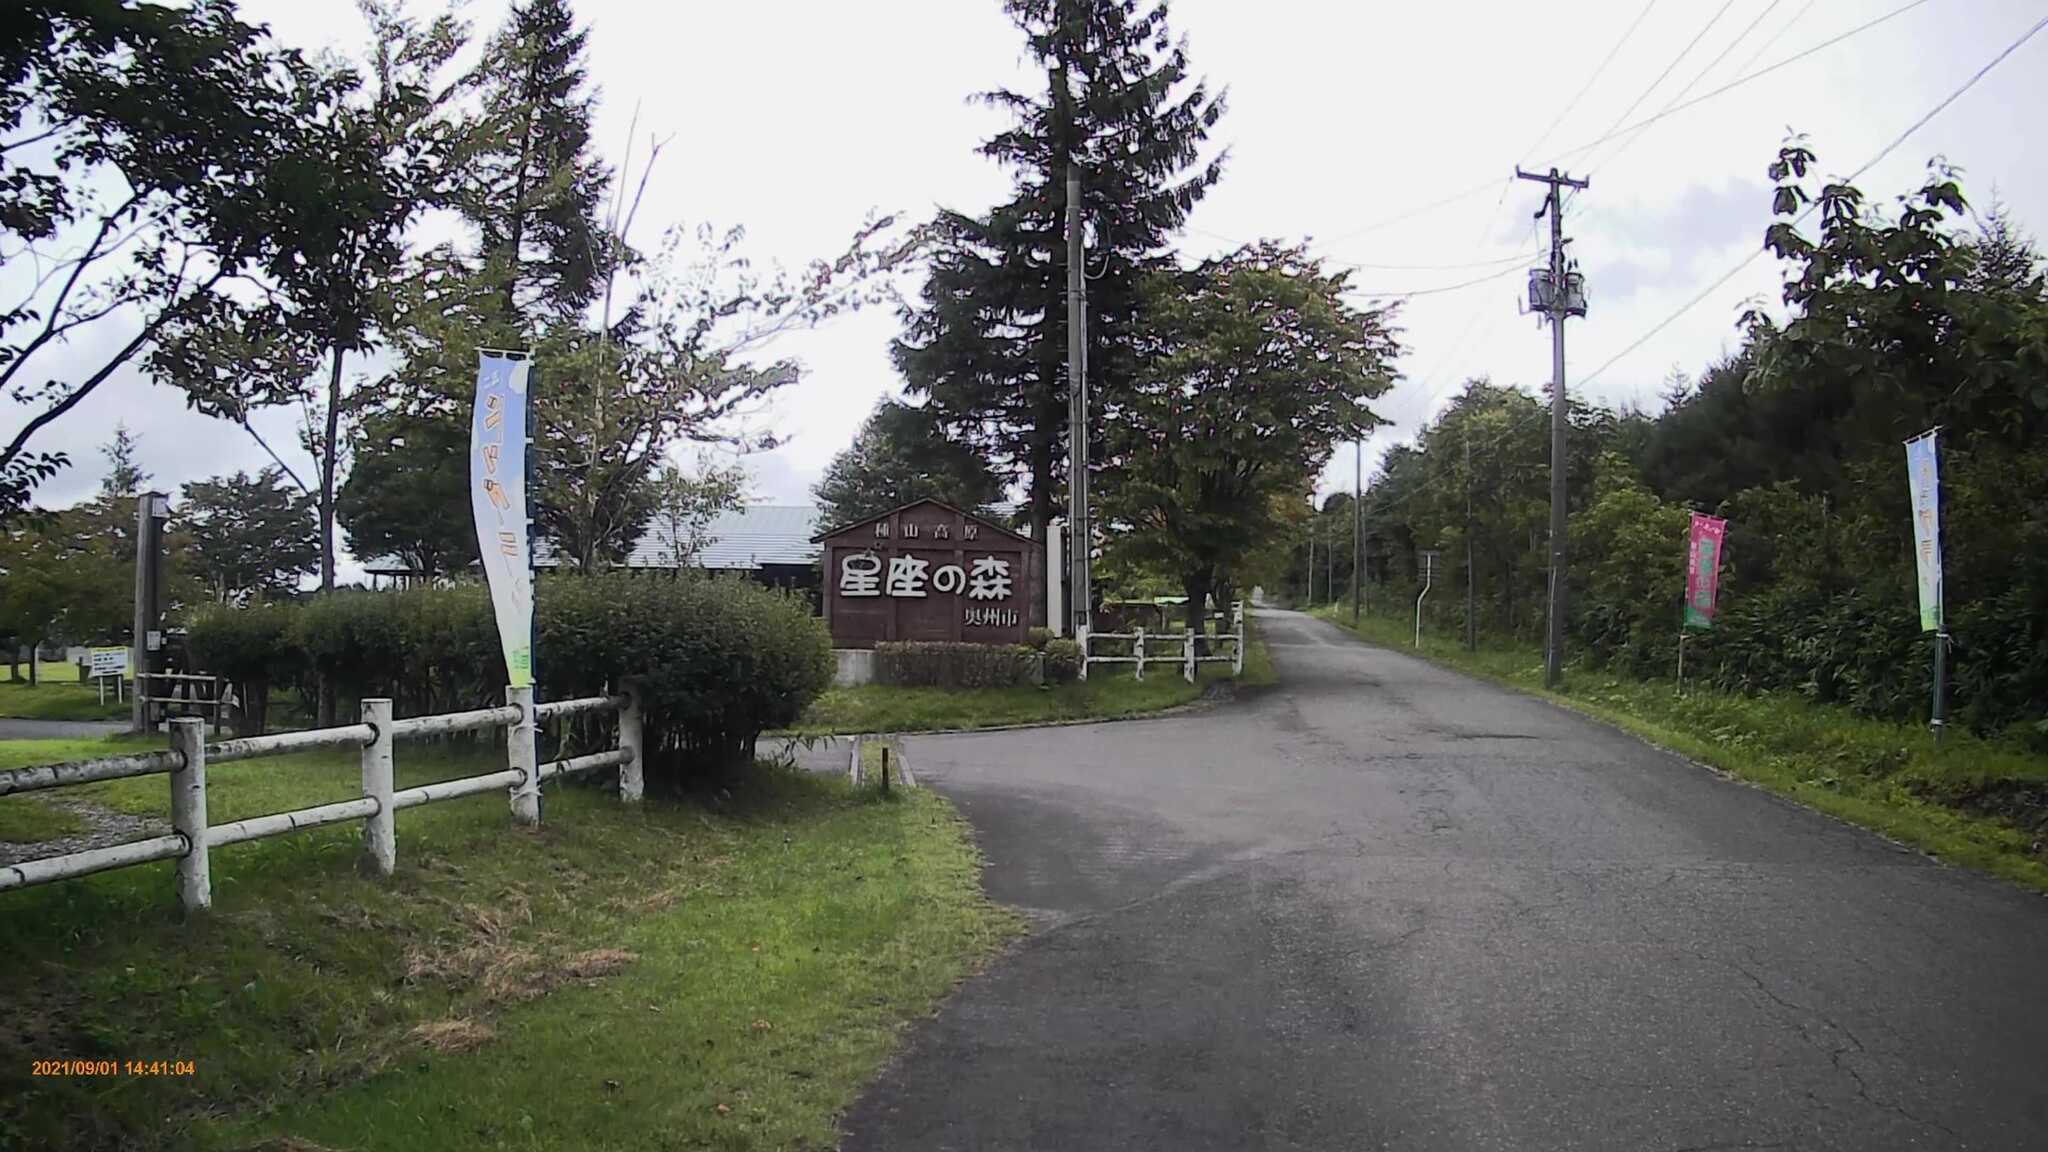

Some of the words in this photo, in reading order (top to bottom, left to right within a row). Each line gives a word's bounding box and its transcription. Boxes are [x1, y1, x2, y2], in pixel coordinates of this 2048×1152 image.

[840, 553, 1013, 601] 星座の森
[965, 608, 1019, 628] 奥州市
